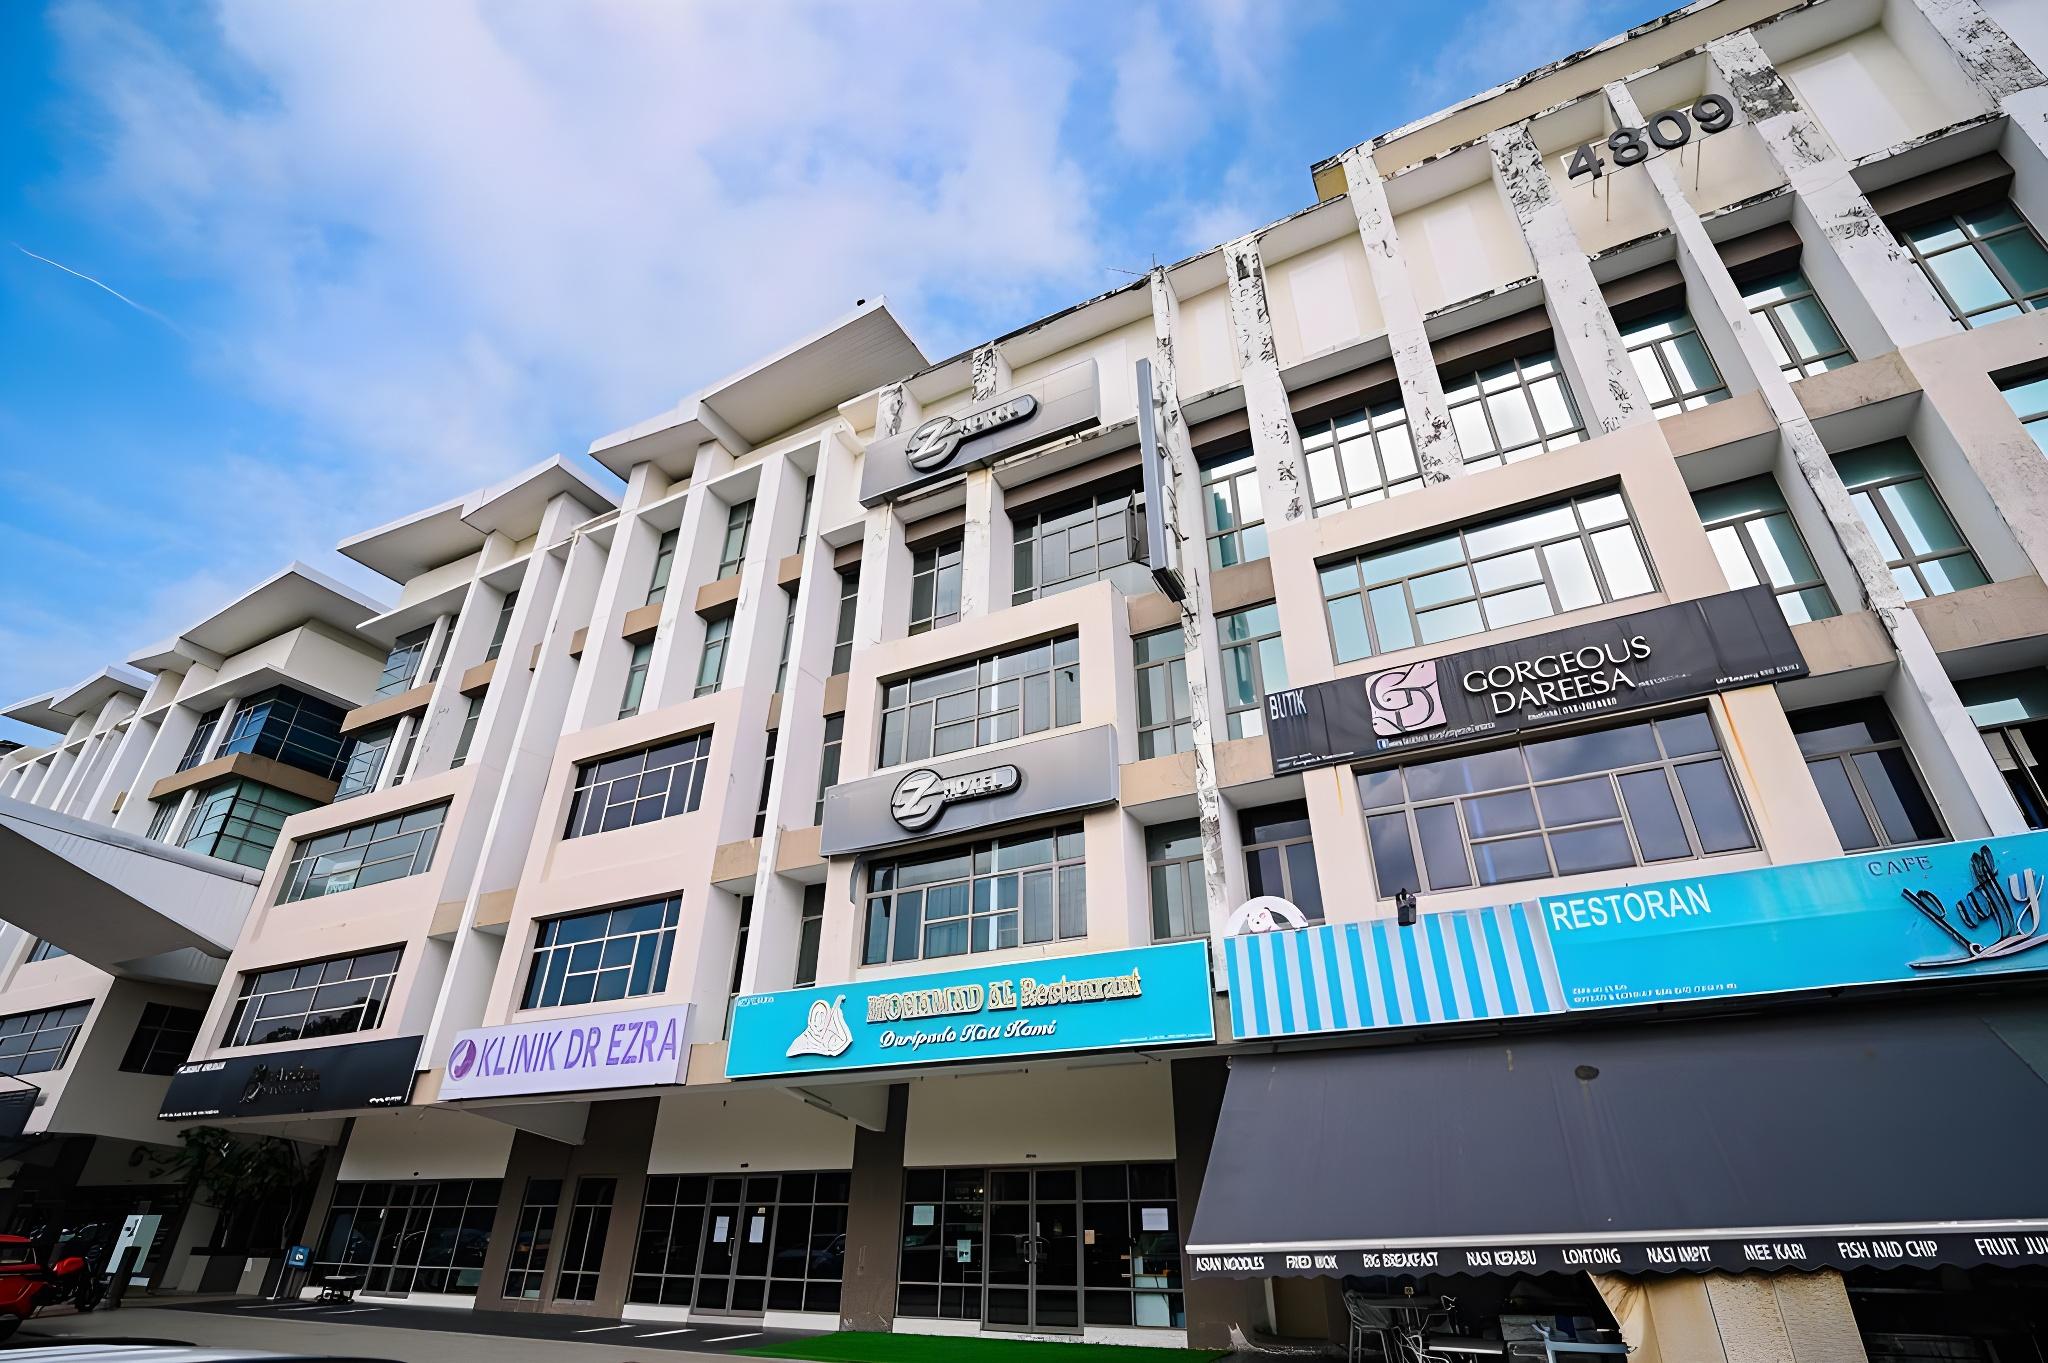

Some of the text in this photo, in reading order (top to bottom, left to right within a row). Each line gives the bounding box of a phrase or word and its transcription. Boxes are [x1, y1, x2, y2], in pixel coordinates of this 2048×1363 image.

[1567, 93, 1734, 180] 4809
[1463, 635, 1651, 693] GORGEOUS
[1491, 667, 1636, 715] DAREESA
[1269, 689, 1307, 720] BUTIK
[1549, 883, 1712, 931] RESTORAN
[476, 1018, 677, 1077] KLINIK DR EZRA
[1465, 1251, 1493, 1266] NASI
[1562, 1247, 1622, 1265] LONTONG
[1646, 1246, 1677, 1263] NASI
[1743, 1243, 1808, 1261] MEE KARI
[1837, 1240, 1938, 1259] FISH AND CHIP
[1974, 1236, 2048, 1256] FRUIT JUI
